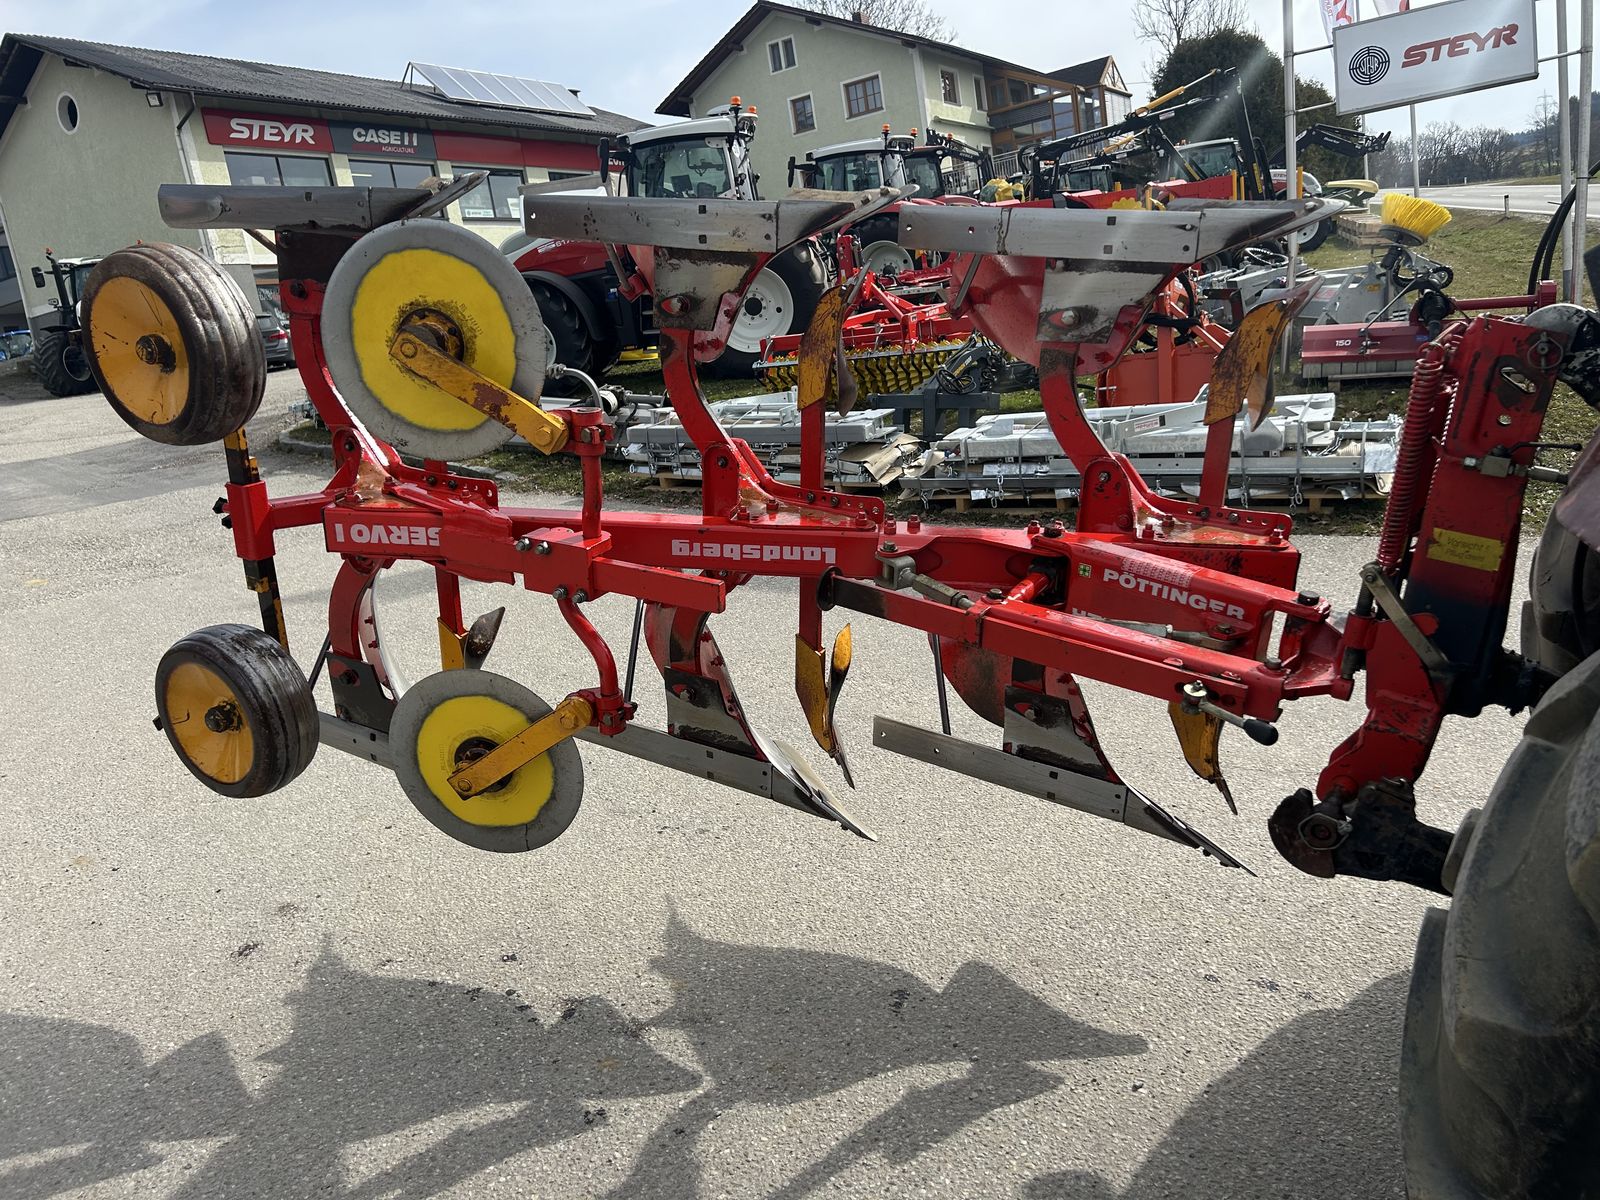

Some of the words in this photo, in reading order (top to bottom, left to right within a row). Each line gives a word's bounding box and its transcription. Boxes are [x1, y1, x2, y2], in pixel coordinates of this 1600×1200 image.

[1401, 23, 1519, 69] STEYR
[1359, 55, 1380, 76] STEYR
[229, 117, 316, 145] STEYR
[352, 127, 401, 145] CASE
[1335, 339, 1352, 347] 150
[349, 523, 442, 547] SERVO
[671, 539, 837, 564] Landsberg
[1103, 568, 1245, 620] PÖTTINGER
